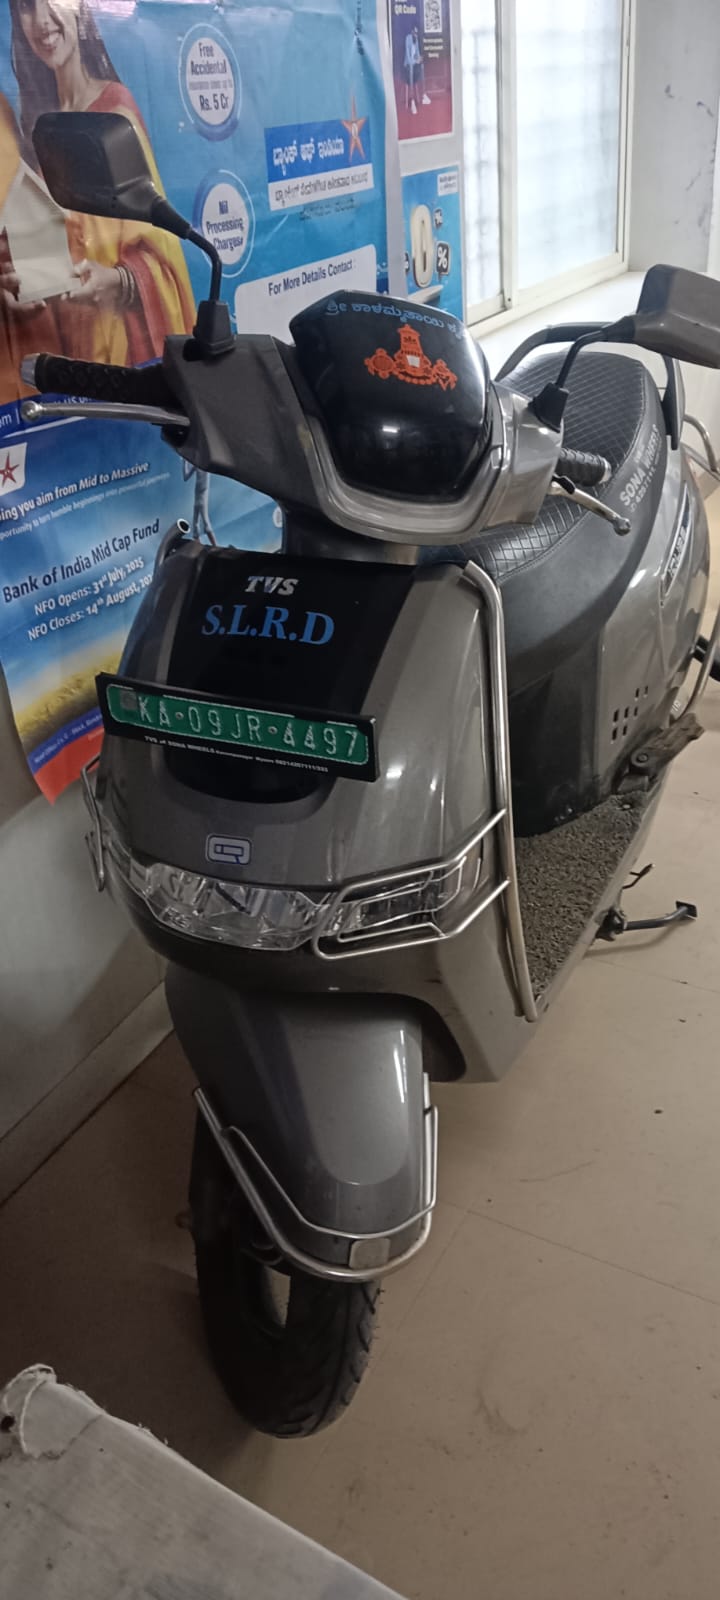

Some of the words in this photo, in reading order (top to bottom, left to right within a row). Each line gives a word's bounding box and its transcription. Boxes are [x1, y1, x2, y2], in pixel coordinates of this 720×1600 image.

[190, 59, 227, 76] Accidental
[198, 42, 215, 58] Free
[199, 94, 212, 111] Rs.
[213, 93, 219, 110] 5
[220, 93, 230, 109] Cr
[206, 218, 245, 234] Processing
[218, 200, 229, 215] Nil
[268, 282, 283, 296] For
[283, 276, 300, 292] More
[301, 268, 327, 285] Details
[328, 259, 353, 277] Contact
[18, 498, 36, 518] you
[36, 491, 54, 506] aim
[55, 483, 78, 499] from
[79, 474, 98, 490] Mid
[98, 473, 110, 484] to
[111, 462, 150, 481] Massive
[620, 467, 647, 506] SONA
[3, 575, 39, 603] Bank
[43, 566, 58, 587] of
[60, 554, 92, 581] India
[91, 540, 112, 566] Mid
[112, 535, 132, 553] Cap
[132, 518, 160, 543] Fund
[34, 599, 56, 616] NFO
[58, 586, 92, 607] Opens:
[107, 566, 127, 588] July,
[127, 556, 145, 574] 2025
[244, 575, 300, 596] TVS
[27, 623, 48, 641] NFO
[49, 610, 85, 631] Closes:
[86, 597, 105, 615] 14th
[105, 582, 141, 607] August,
[201, 604, 335, 645] S.L.R.D
